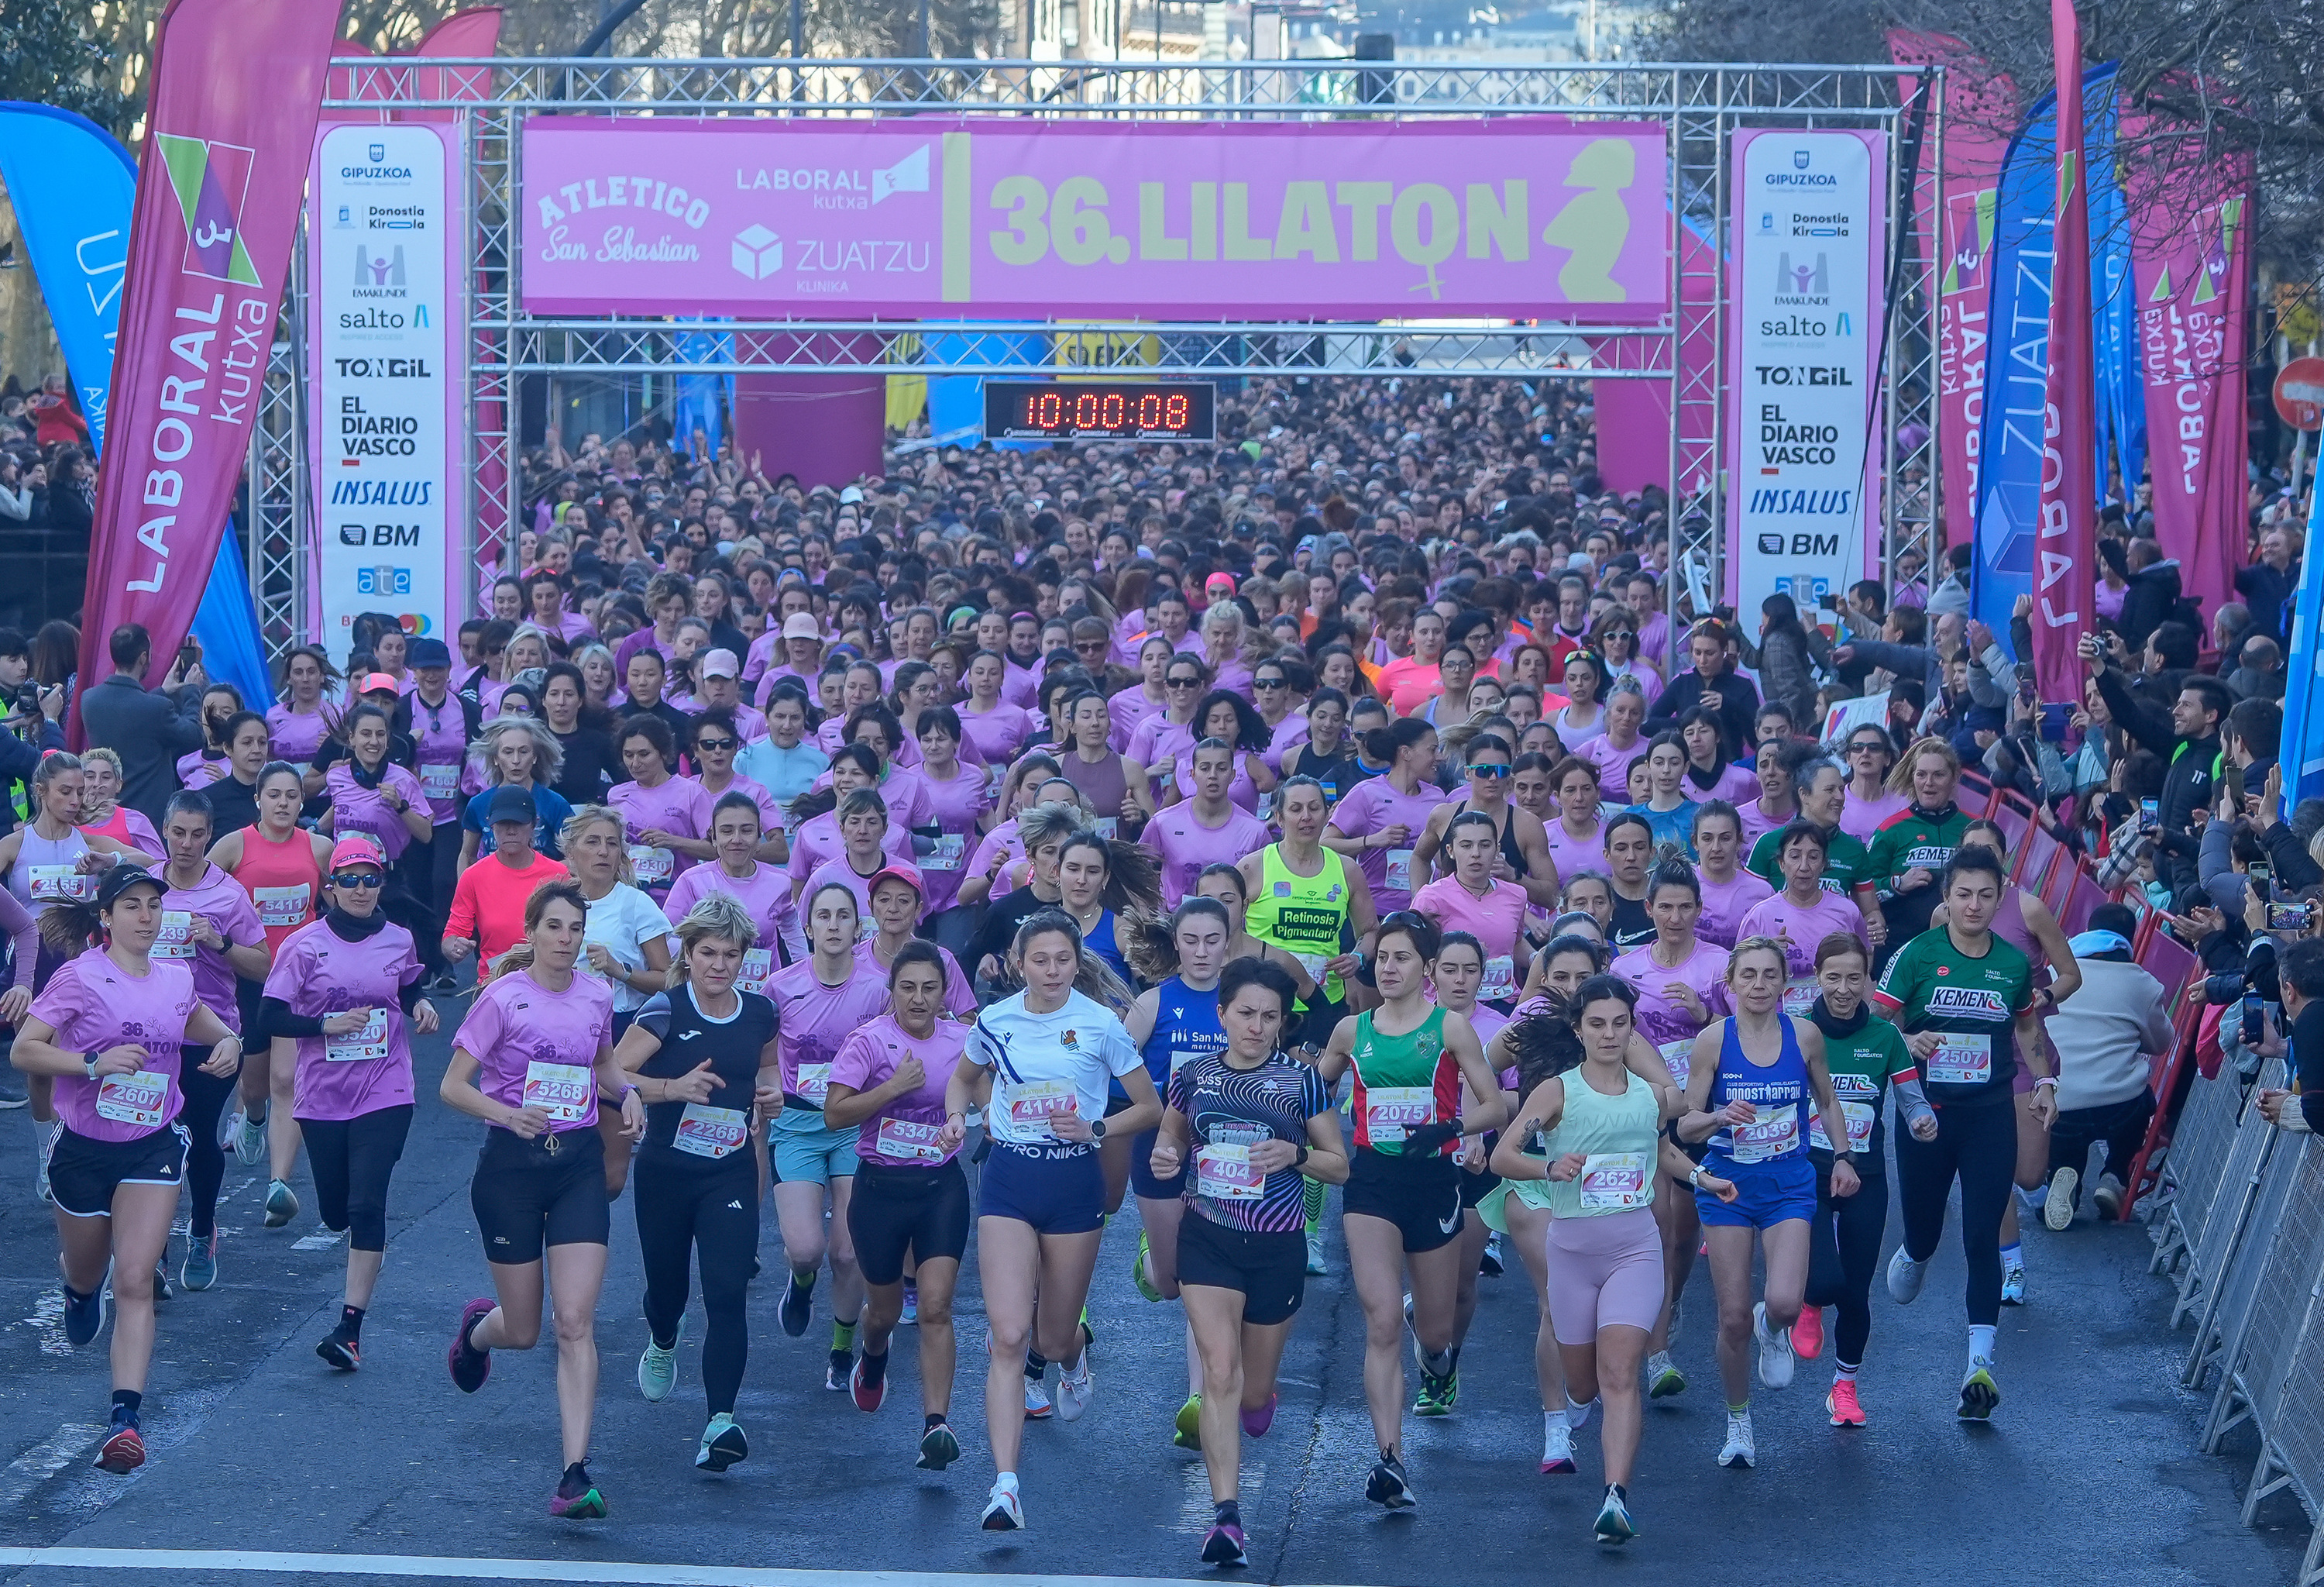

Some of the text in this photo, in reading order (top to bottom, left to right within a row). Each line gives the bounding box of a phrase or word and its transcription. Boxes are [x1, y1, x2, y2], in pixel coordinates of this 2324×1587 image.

[341, 167, 411, 178] GIPUZKOA
[736, 168, 868, 190] LABORAL
[1765, 174, 1837, 185] GIPUZKOA
[369, 205, 425, 215] Donostia
[538, 176, 710, 230] ATLETICO
[813, 194, 868, 210] kutxa
[369, 219, 425, 229] Kirola
[1793, 213, 1849, 224] Donostia
[1793, 225, 1849, 236] Kirola
[541, 225, 700, 263] San Sebastian
[796, 240, 930, 272] ZUATZU
[352, 288, 408, 298] EMAKUNDE
[796, 281, 849, 292] KLINIKA
[1775, 296, 1831, 306] EMAKUNDE
[339, 308, 404, 329] salto
[1761, 315, 1827, 336] salto
[210, 298, 269, 425] kutxa
[342, 396, 366, 414] EL
[1027, 393, 1188, 429] 10:00:08
[1762, 404, 1786, 422] EL
[342, 416, 418, 435] DIARIO
[1761, 425, 1838, 443] DIARIO
[125, 292, 225, 593] LABORAL
[342, 438, 416, 456] VASCO
[1762, 446, 1837, 465] VASCO
[332, 480, 432, 504] INSALUS
[1749, 489, 1851, 514] INSALUS
[373, 525, 420, 546] BM
[1791, 534, 1839, 556] BM
[358, 567, 411, 595] ate
[635, 859, 667, 872] 1930
[40, 879, 79, 891] 2555
[266, 898, 303, 912] 5411
[1284, 910, 1336, 926] Retinosis
[158, 927, 187, 940] 239
[743, 962, 762, 976] 18
[1933, 989, 1990, 1008] KEMEN
[122, 1021, 150, 1038] 36.
[1191, 1031, 1228, 1044] San Ma
[1938, 1049, 1983, 1065] 2507
[537, 1081, 583, 1100] 5268
[809, 1078, 828, 1093] 28
[112, 1085, 160, 1106] 2607
[1021, 1096, 1068, 1116] 4117
[1377, 1105, 1425, 1121] 2075
[691, 1121, 739, 1141] 2268
[892, 1121, 940, 1141] 5347
[1745, 1123, 1792, 1141] 2039
[1845, 1119, 1865, 1134] 08
[1002, 1141, 1088, 1160] PRO NIKE
[1213, 1161, 1250, 1179] 404
[1593, 1171, 1638, 1186] 2621
